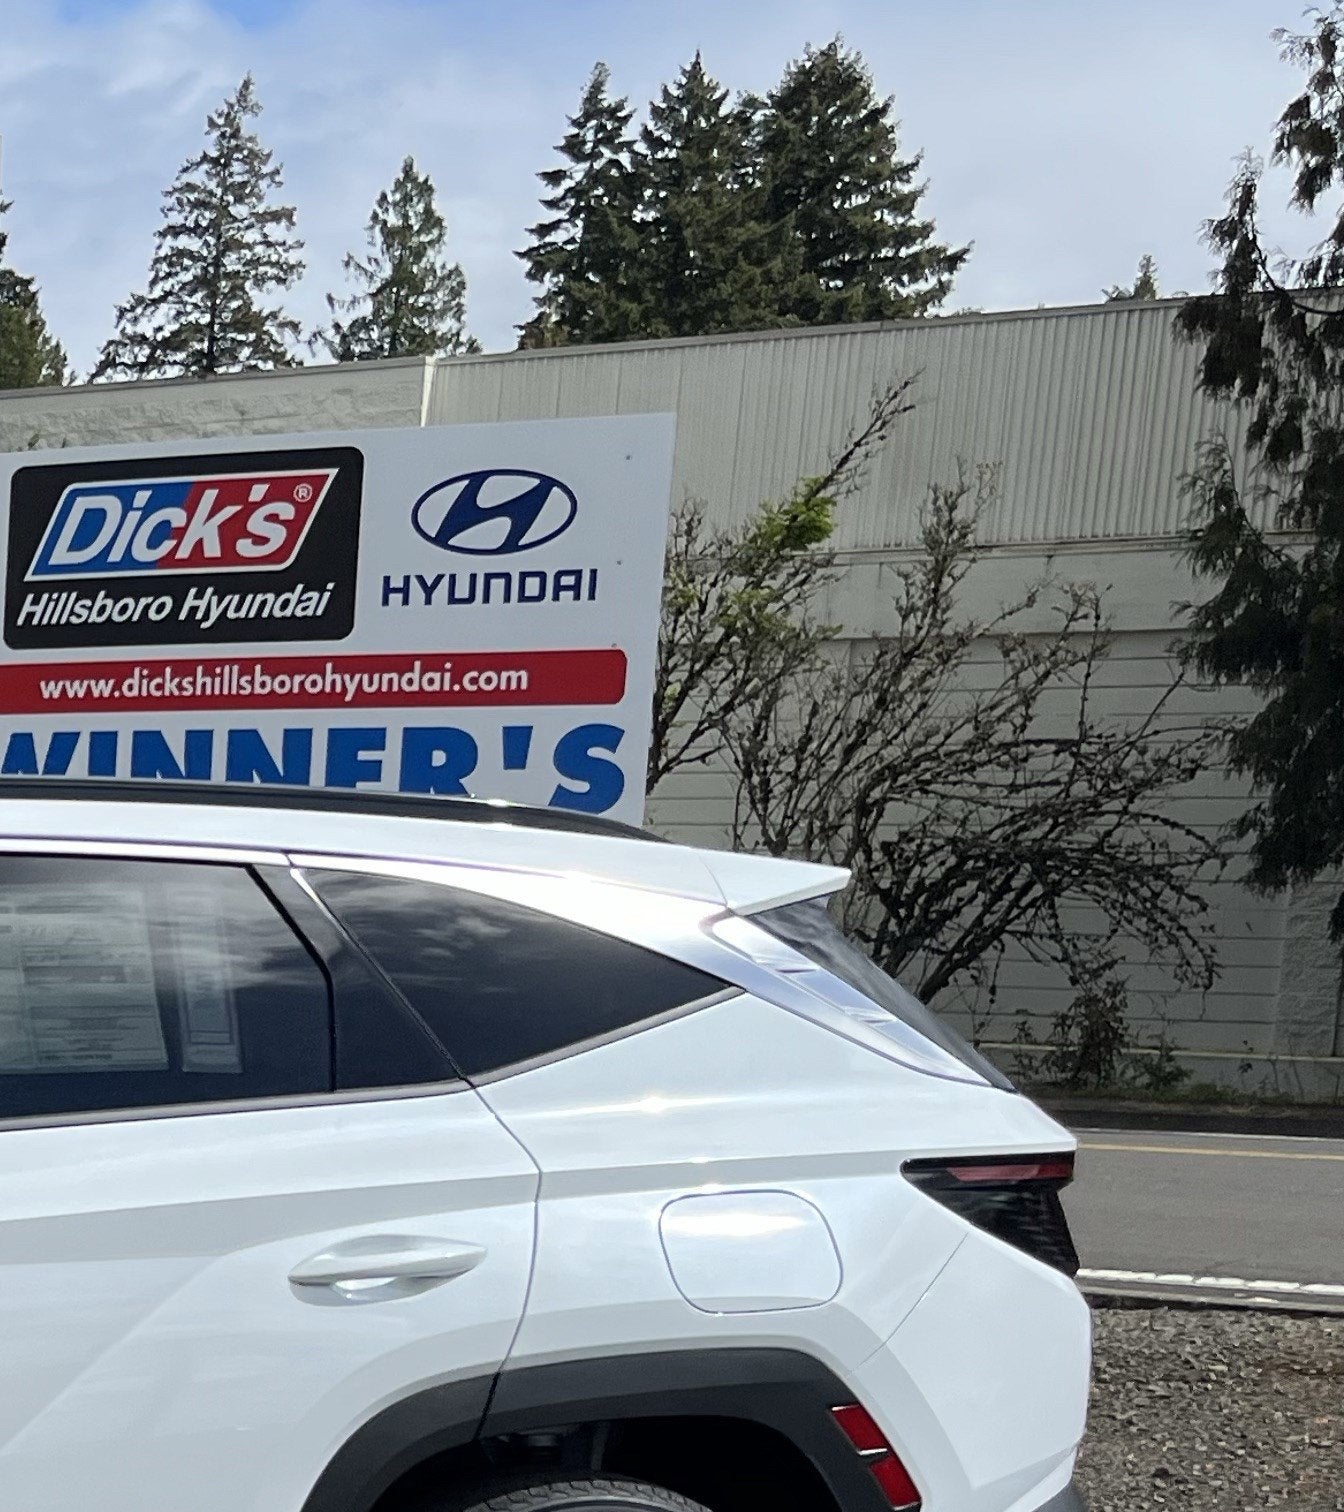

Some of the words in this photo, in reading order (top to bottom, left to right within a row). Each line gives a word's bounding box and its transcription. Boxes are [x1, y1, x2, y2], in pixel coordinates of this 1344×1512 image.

[17, 591, 173, 627] Hillsboro
[178, 582, 335, 629] Hyundai
[382, 569, 597, 606] HYUNDAI
[40, 661, 528, 701] www.dickshillsborohyundai.com
